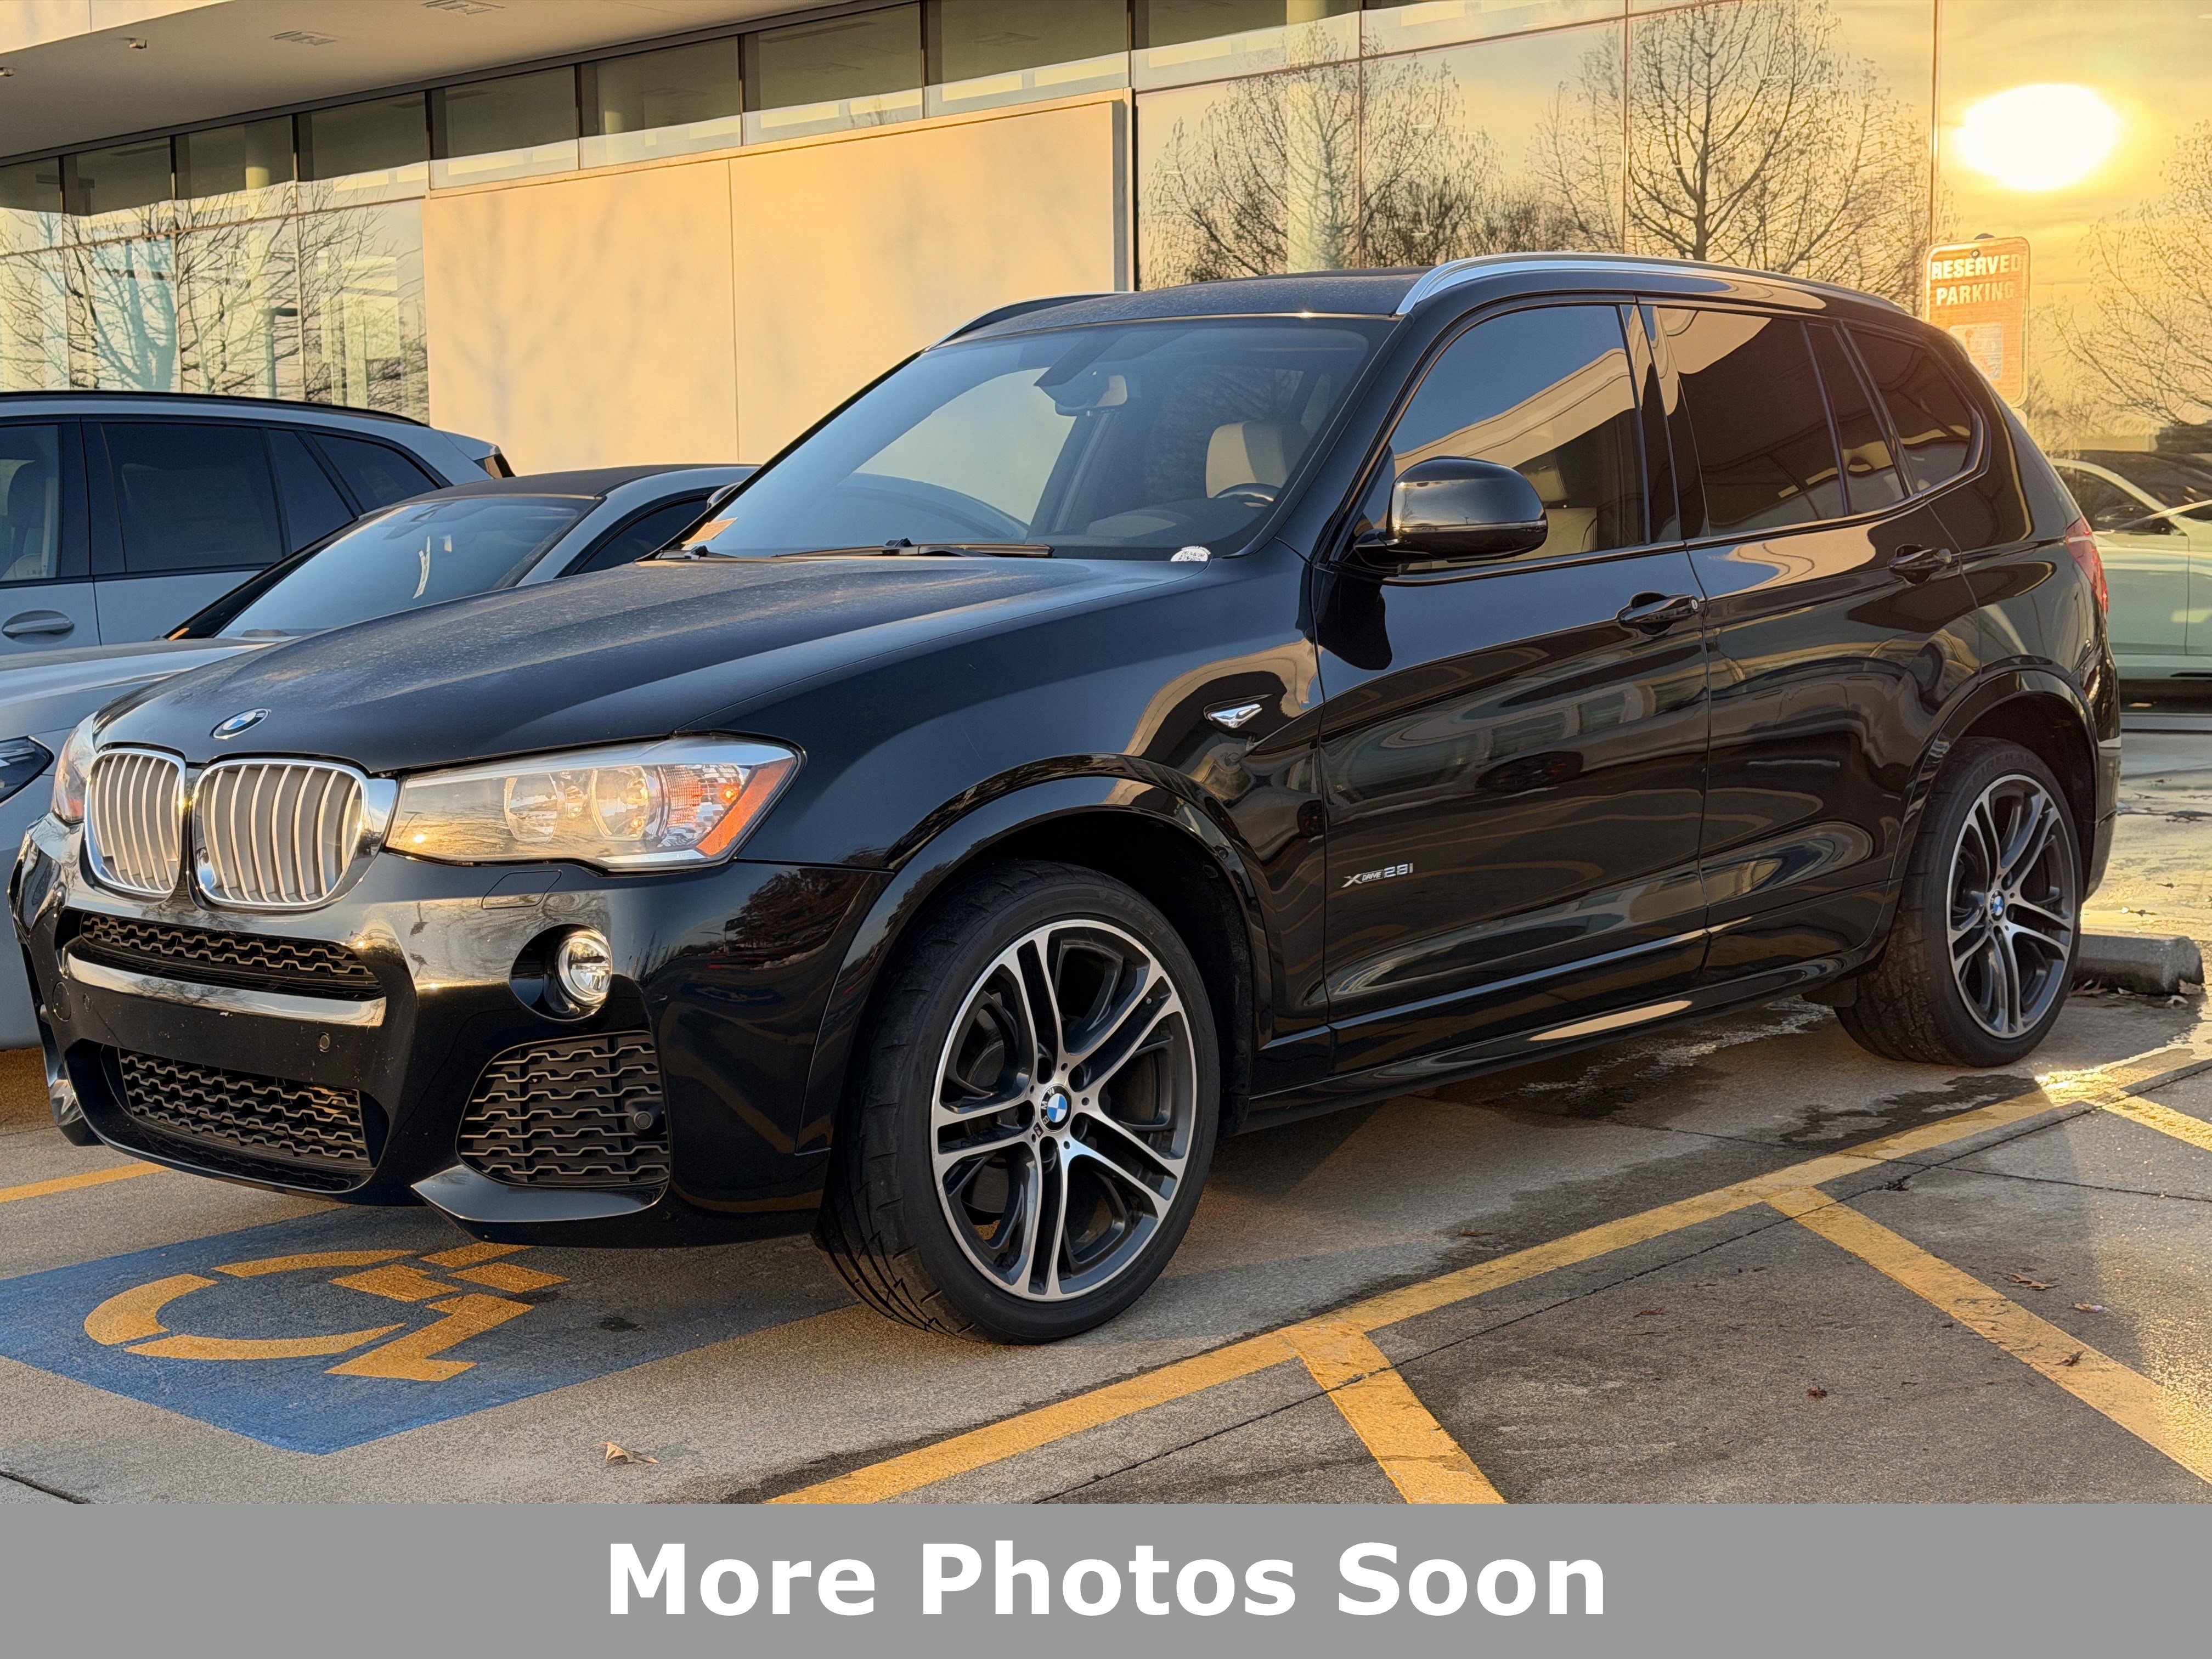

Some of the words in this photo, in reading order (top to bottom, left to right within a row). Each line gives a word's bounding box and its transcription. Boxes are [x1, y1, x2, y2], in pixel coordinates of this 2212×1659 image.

[1931, 253, 2022, 280] RESERVED
[1936, 281, 2015, 306] PARKING
[1041, 1087, 1056, 1125] BMW
